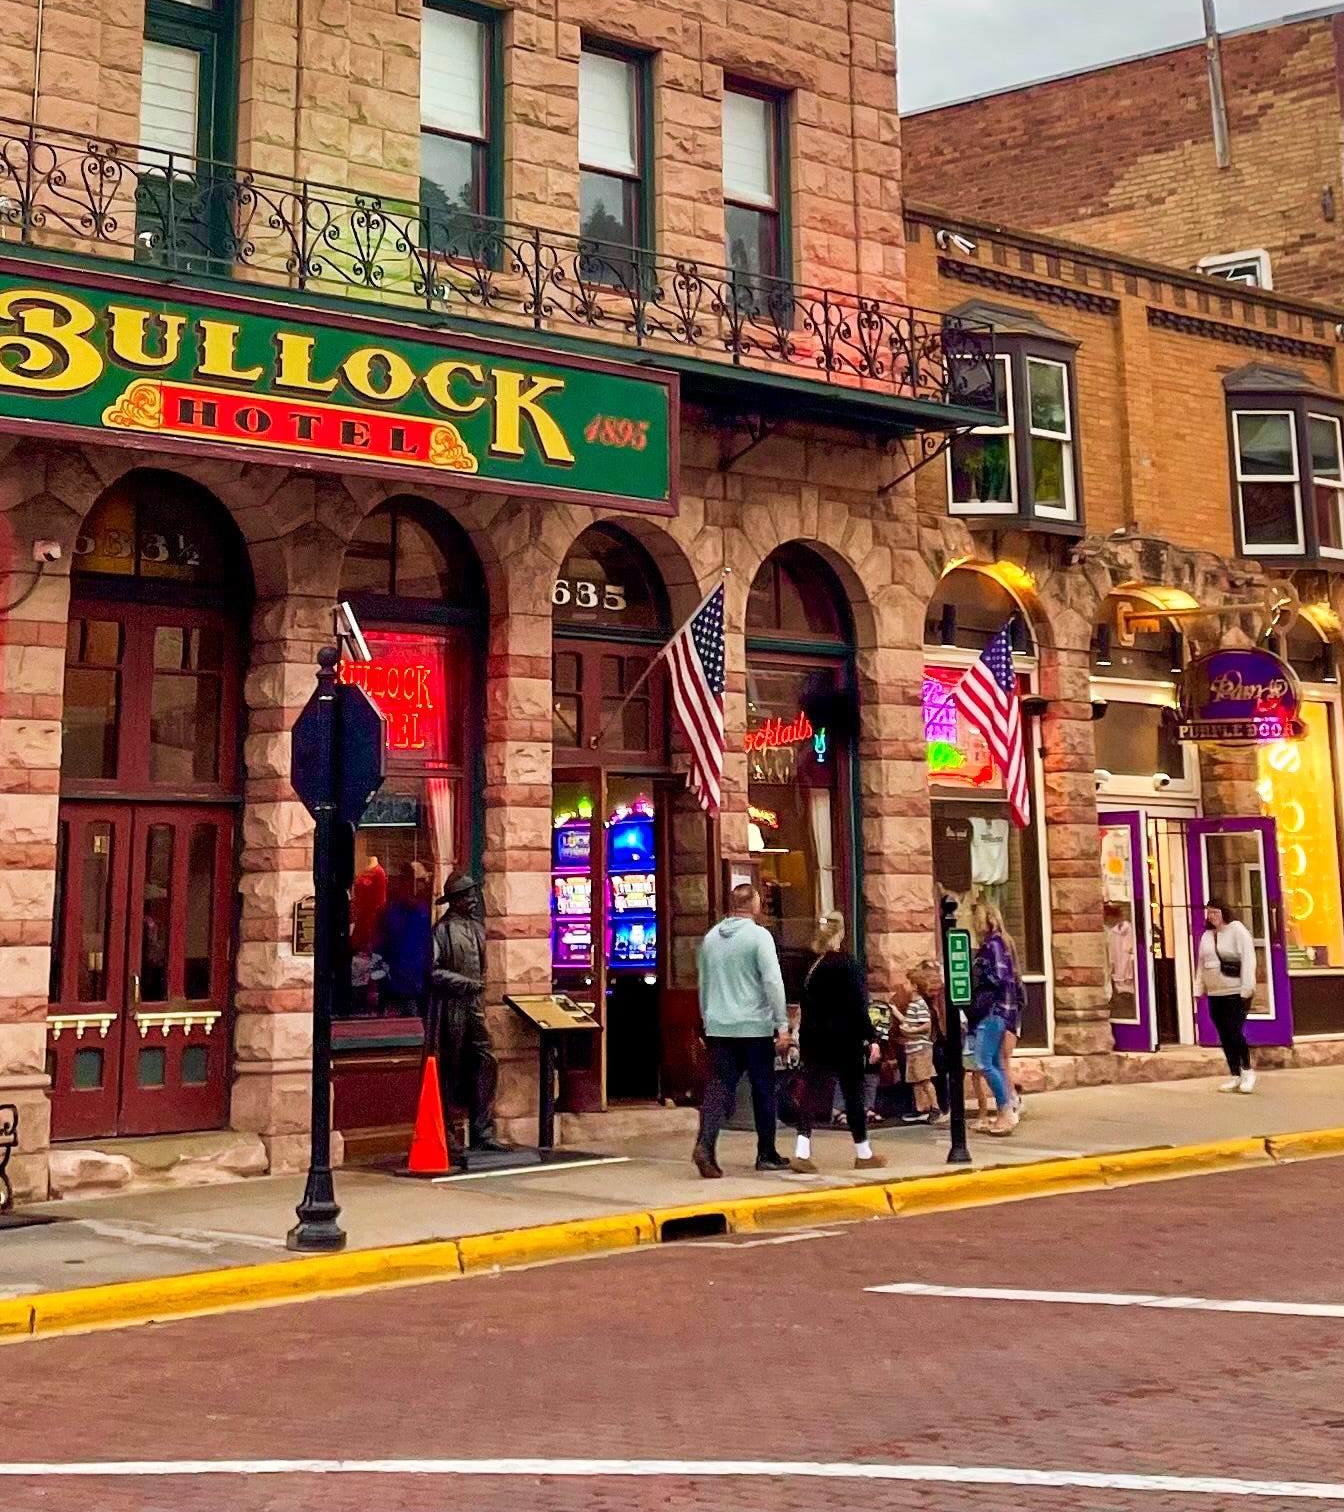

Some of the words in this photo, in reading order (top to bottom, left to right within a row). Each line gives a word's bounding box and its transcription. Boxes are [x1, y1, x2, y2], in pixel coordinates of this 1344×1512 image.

[177, 396, 422, 456] HOTEL
[585, 414, 649, 451] 1895
[552, 579, 627, 611] 635
[744, 710, 813, 753] ocktails
